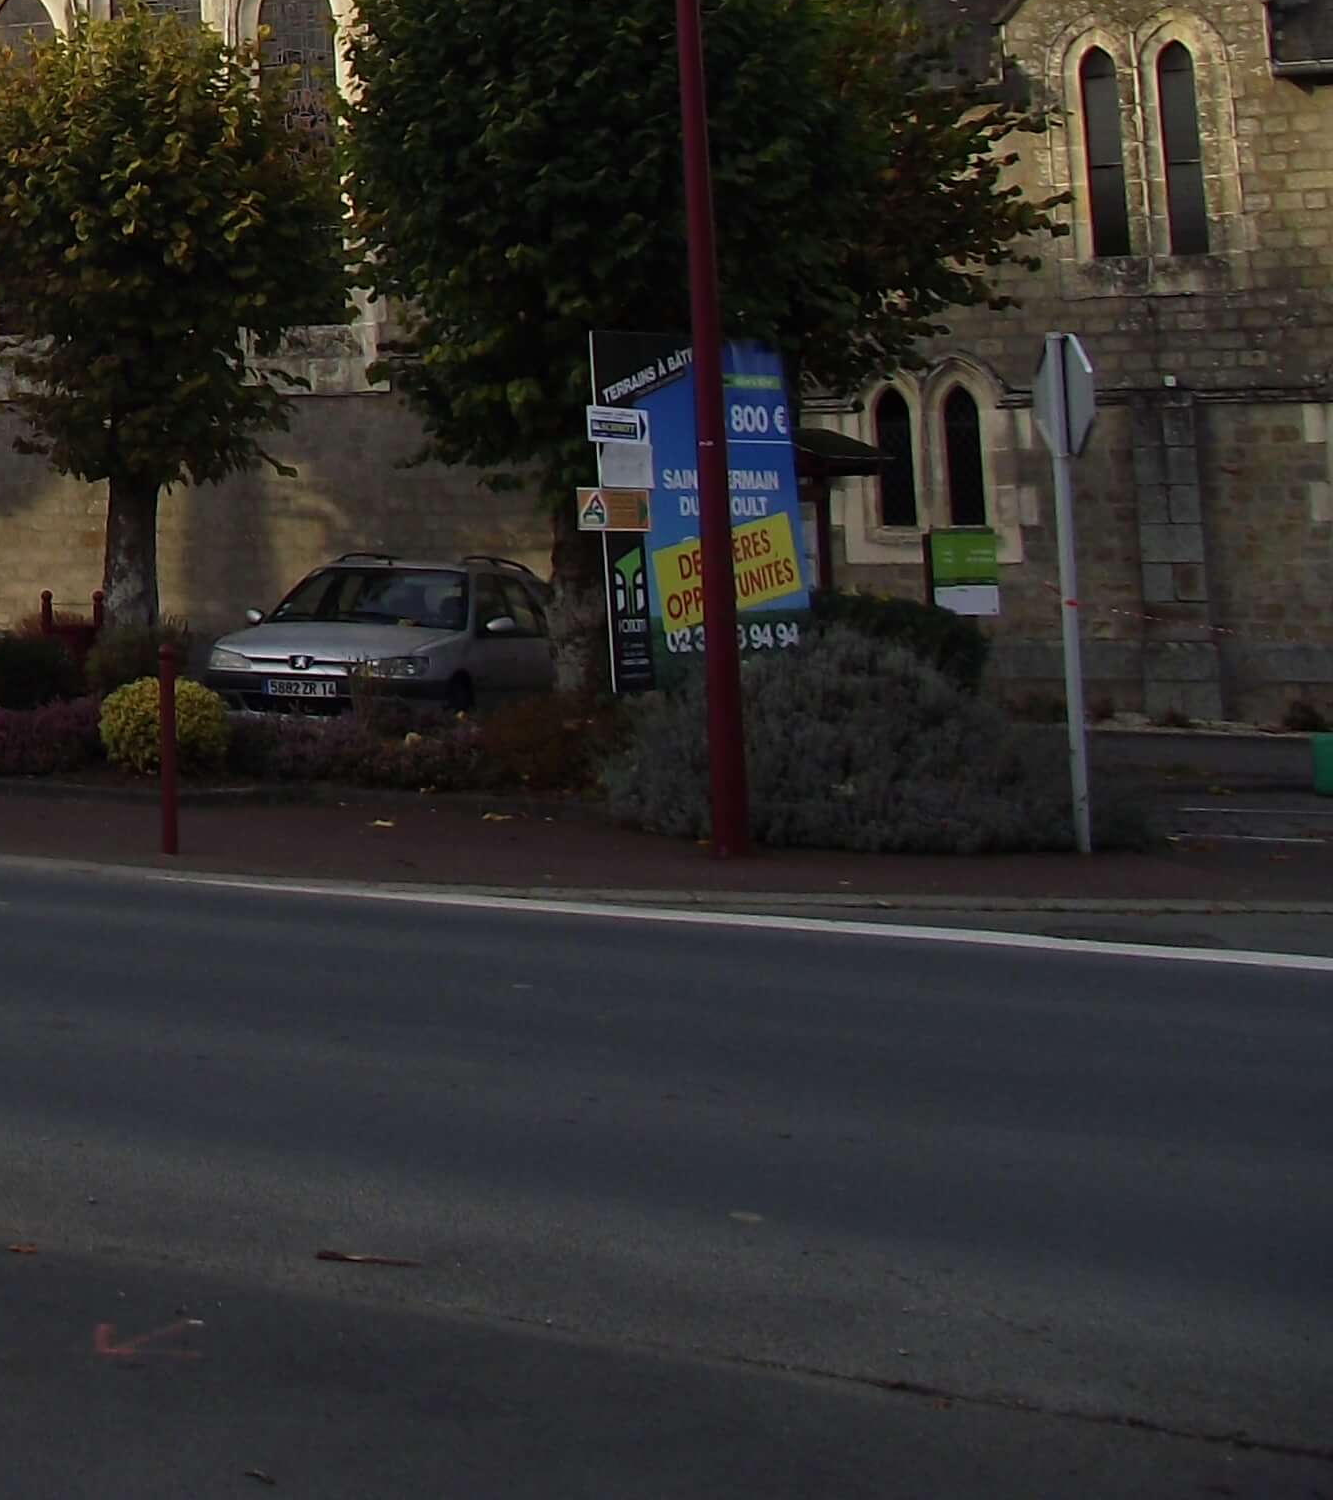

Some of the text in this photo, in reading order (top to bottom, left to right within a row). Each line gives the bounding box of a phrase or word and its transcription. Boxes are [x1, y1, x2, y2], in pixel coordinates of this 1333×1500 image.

[601, 365, 657, 404] TERRAINS
[656, 357, 669, 378] À
[666, 346, 694, 373] BÂTI
[729, 404, 788, 435] 800 €
[662, 468, 699, 491] SAIN
[748, 622, 773, 650] 94
[775, 621, 799, 649] 94
